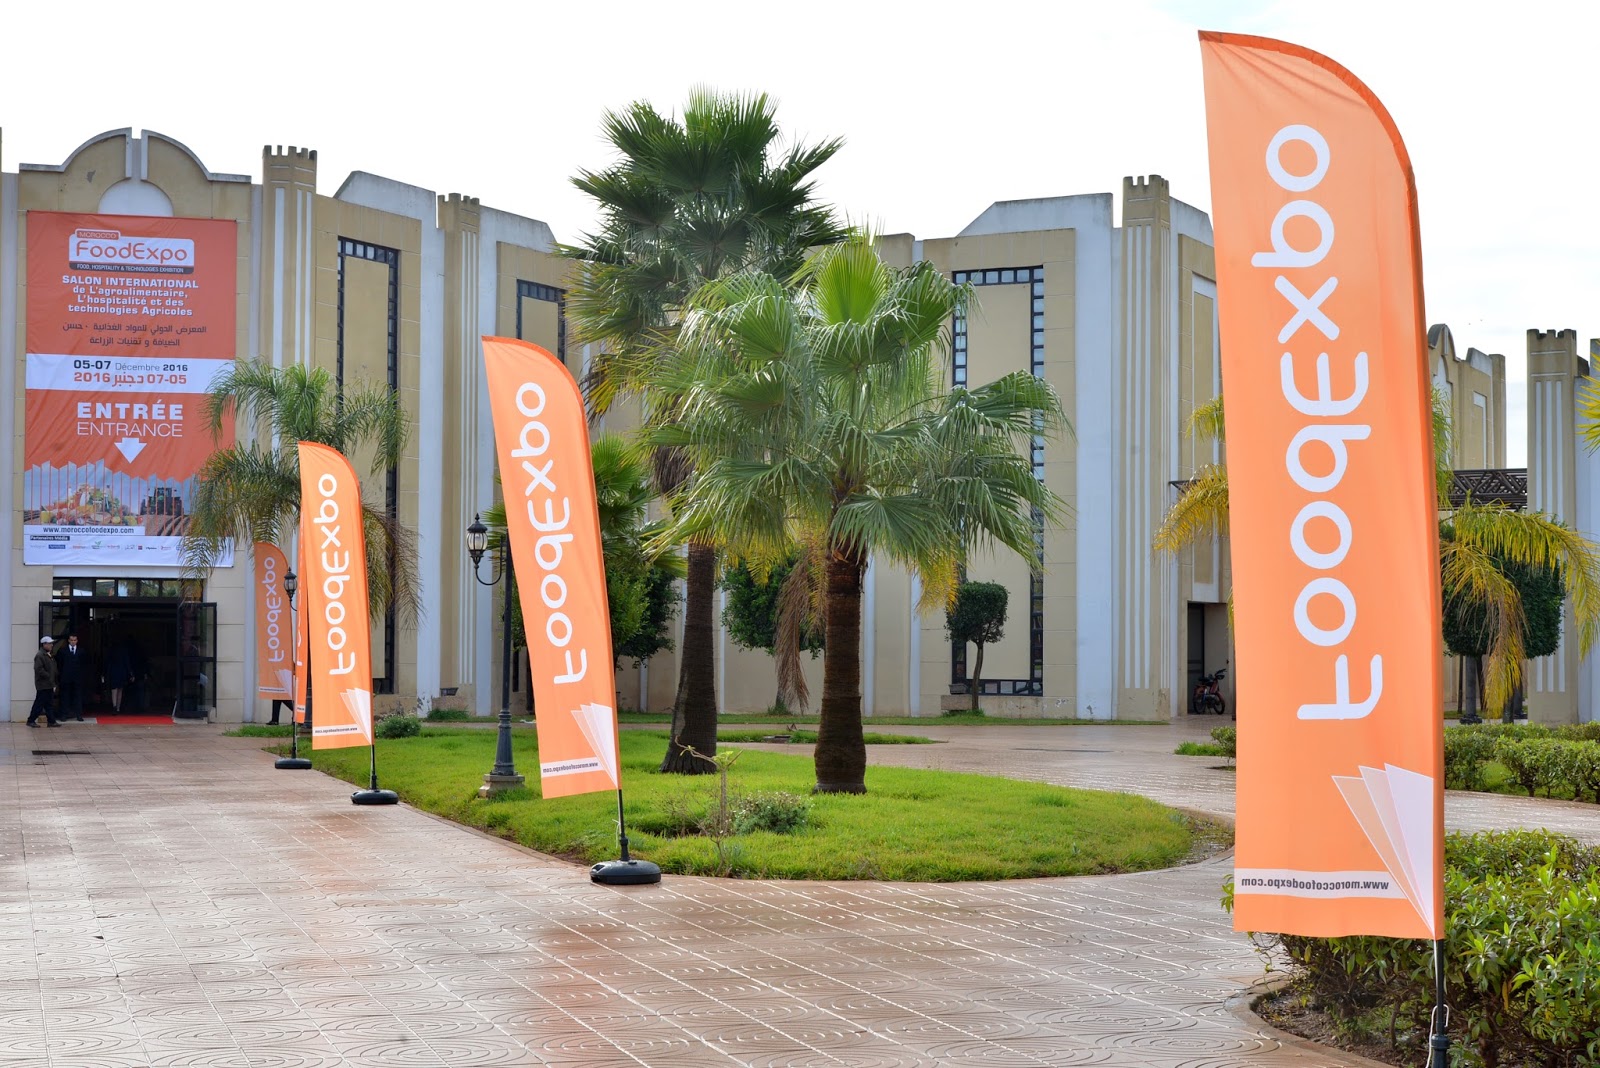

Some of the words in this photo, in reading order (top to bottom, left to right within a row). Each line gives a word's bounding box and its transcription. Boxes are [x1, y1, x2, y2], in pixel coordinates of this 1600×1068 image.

[79, 231, 117, 239] MOROCCO
[76, 240, 188, 264] FoodExpo
[62, 275, 102, 285] SALON
[105, 277, 199, 288] INTERNATIONAL
[73, 285, 86, 294] de
[89, 286, 188, 298] L'agroalimentaire,
[77, 295, 147, 306] L'hospitalité
[165, 298, 184, 307] des
[68, 304, 138, 316] technologies
[141, 306, 193, 317] Agricoles
[125, 324, 147, 333] للمواد
[150, 325, 173, 335] الدولي
[175, 325, 207, 335] المعرض
[89, 337, 114, 346] الزراعة
[117, 337, 142, 346] تقنيات
[144, 339, 150, 347] و
[152, 338, 180, 347] الضيافة
[73, 360, 112, 370] 05-07
[115, 362, 160, 371] Décembre
[73, 372, 111, 383] 2016
[77, 399, 184, 420] ENTRÉE
[77, 422, 183, 437] ENTRANCE
